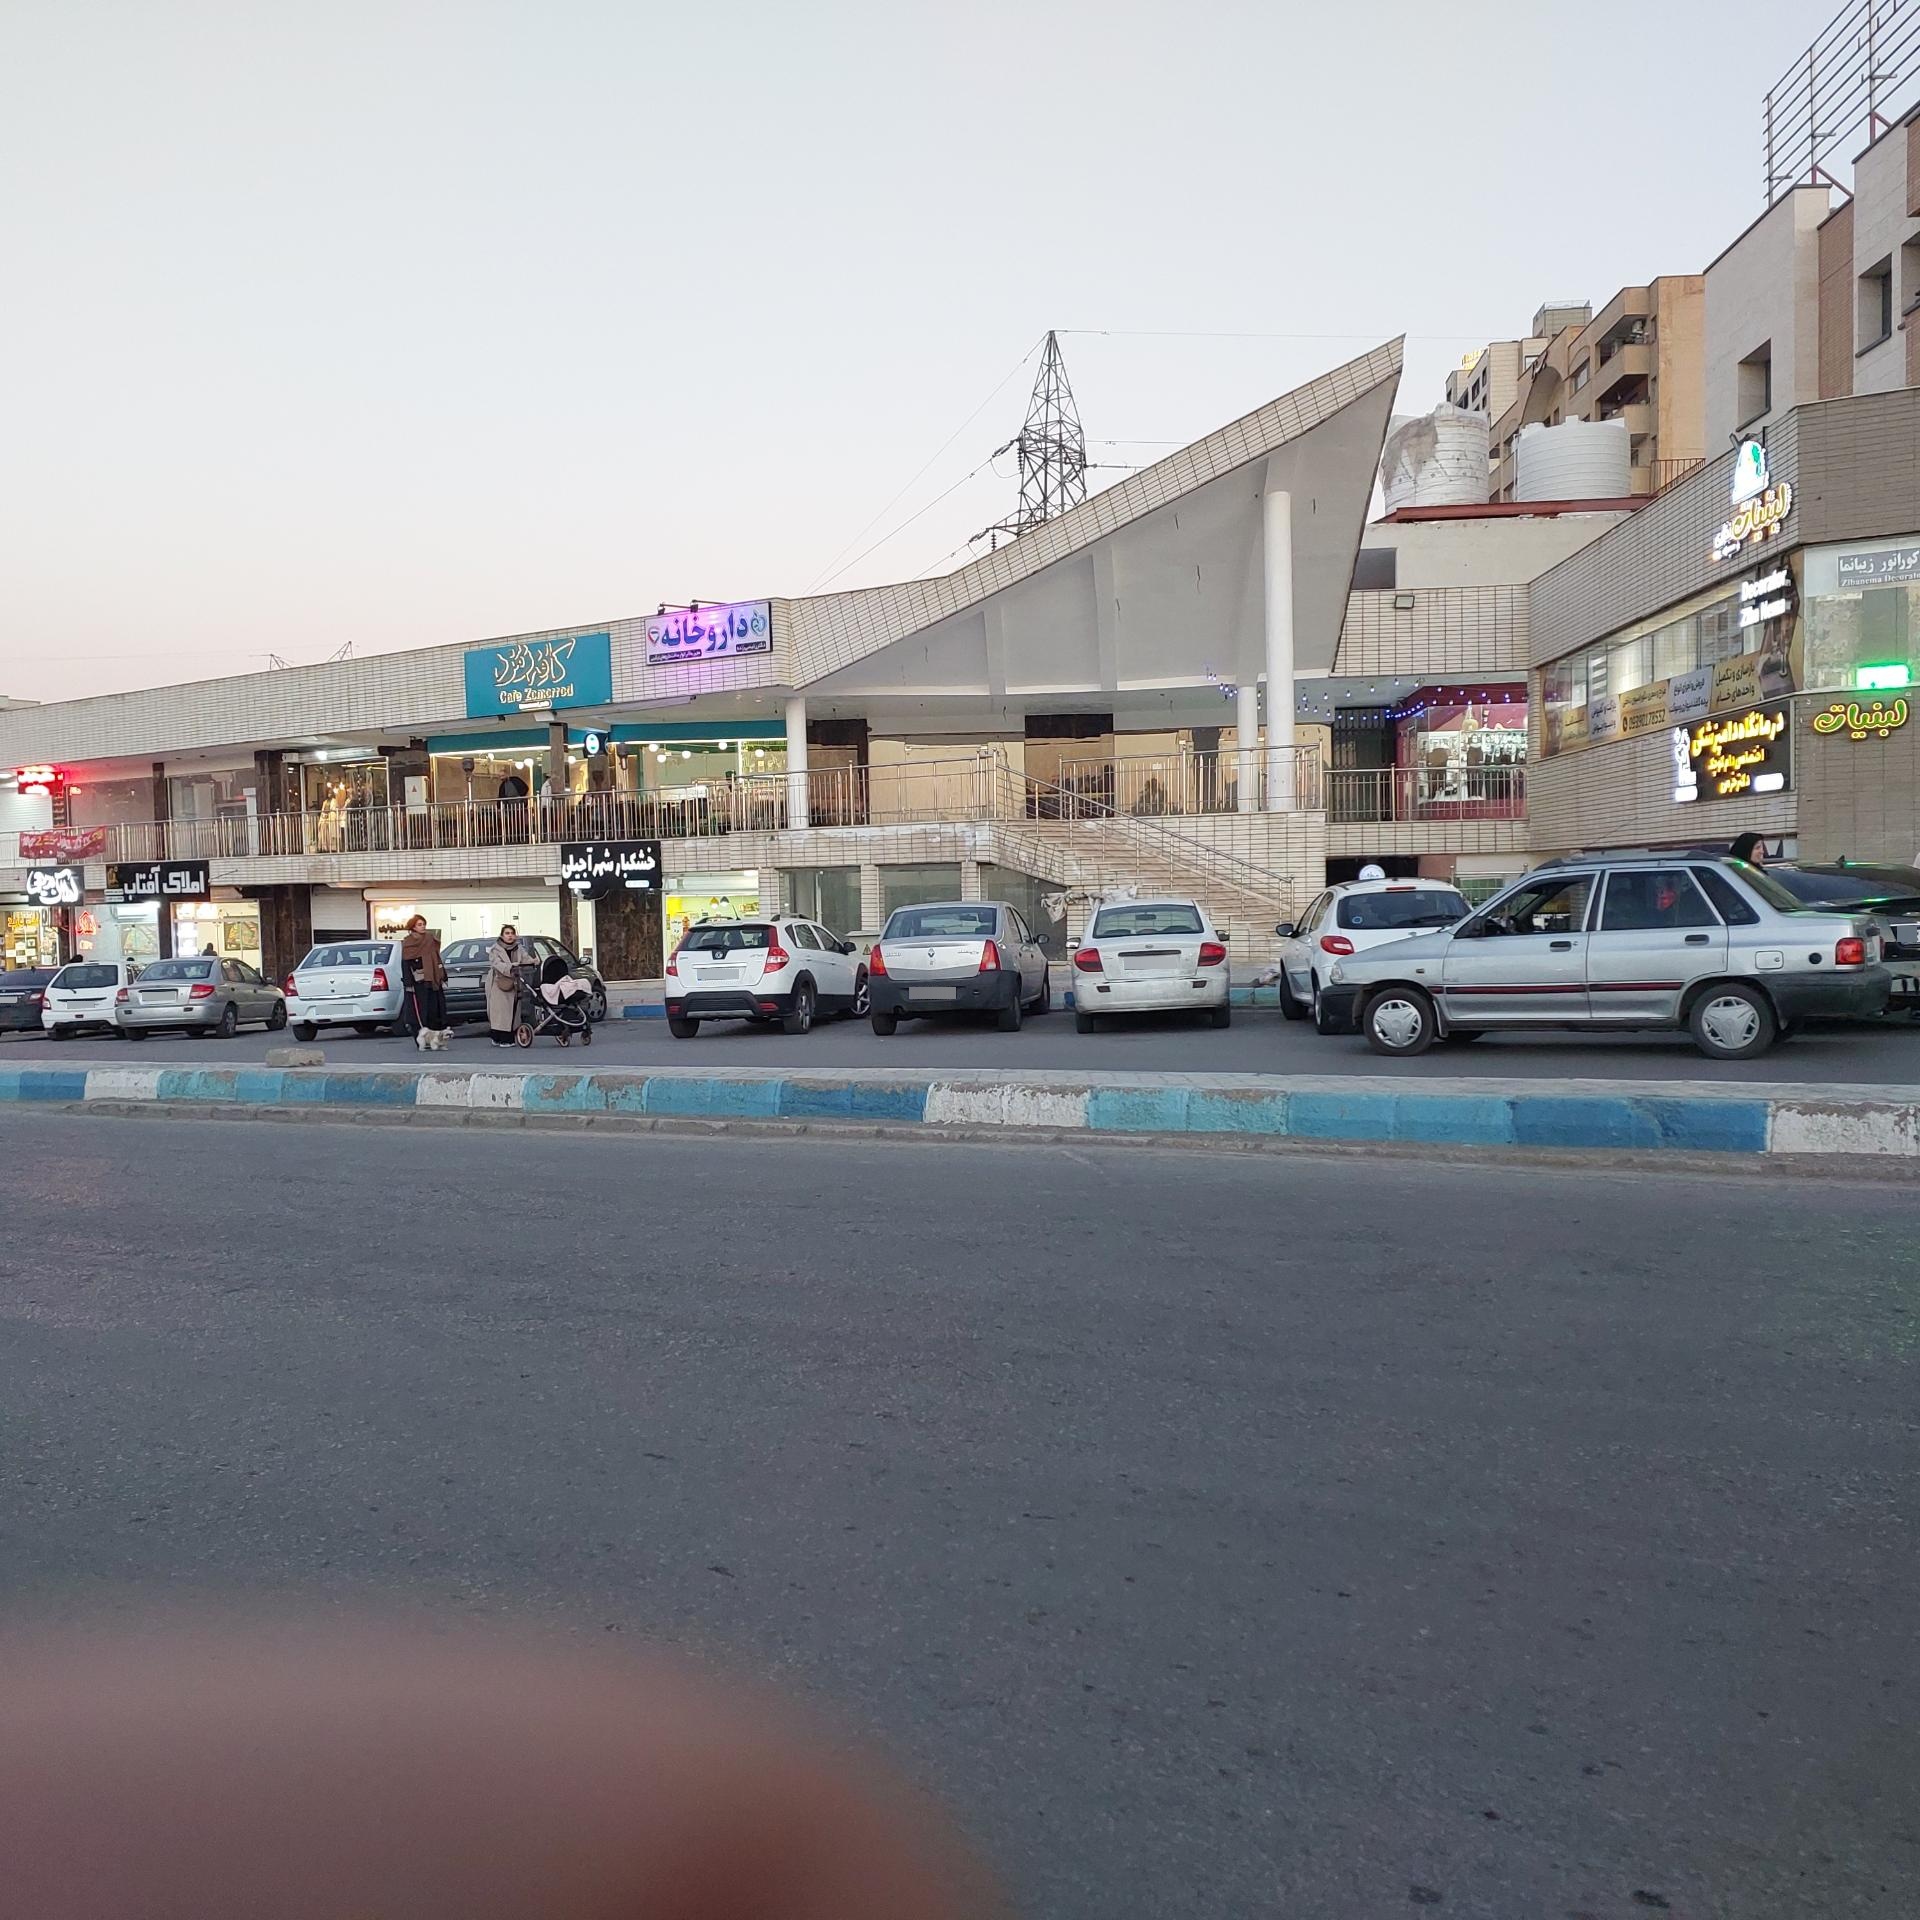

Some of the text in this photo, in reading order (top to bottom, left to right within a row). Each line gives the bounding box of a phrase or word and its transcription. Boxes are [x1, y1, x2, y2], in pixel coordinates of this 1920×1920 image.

[1733, 482, 1792, 543] لبنیات
[1840, 550, 1920, 573] کوراتور زیبانما
[661, 609, 748, 653] داروخانه
[500, 690, 522, 703] Cafe
[1690, 711, 1784, 758] درمانگاه دامپزشکی
[1813, 698, 1910, 739] لبنیات
[562, 846, 656, 879] خشکبار شهر آجیلی
[123, 864, 160, 901] آفتاب
[162, 870, 205, 894] املاک
